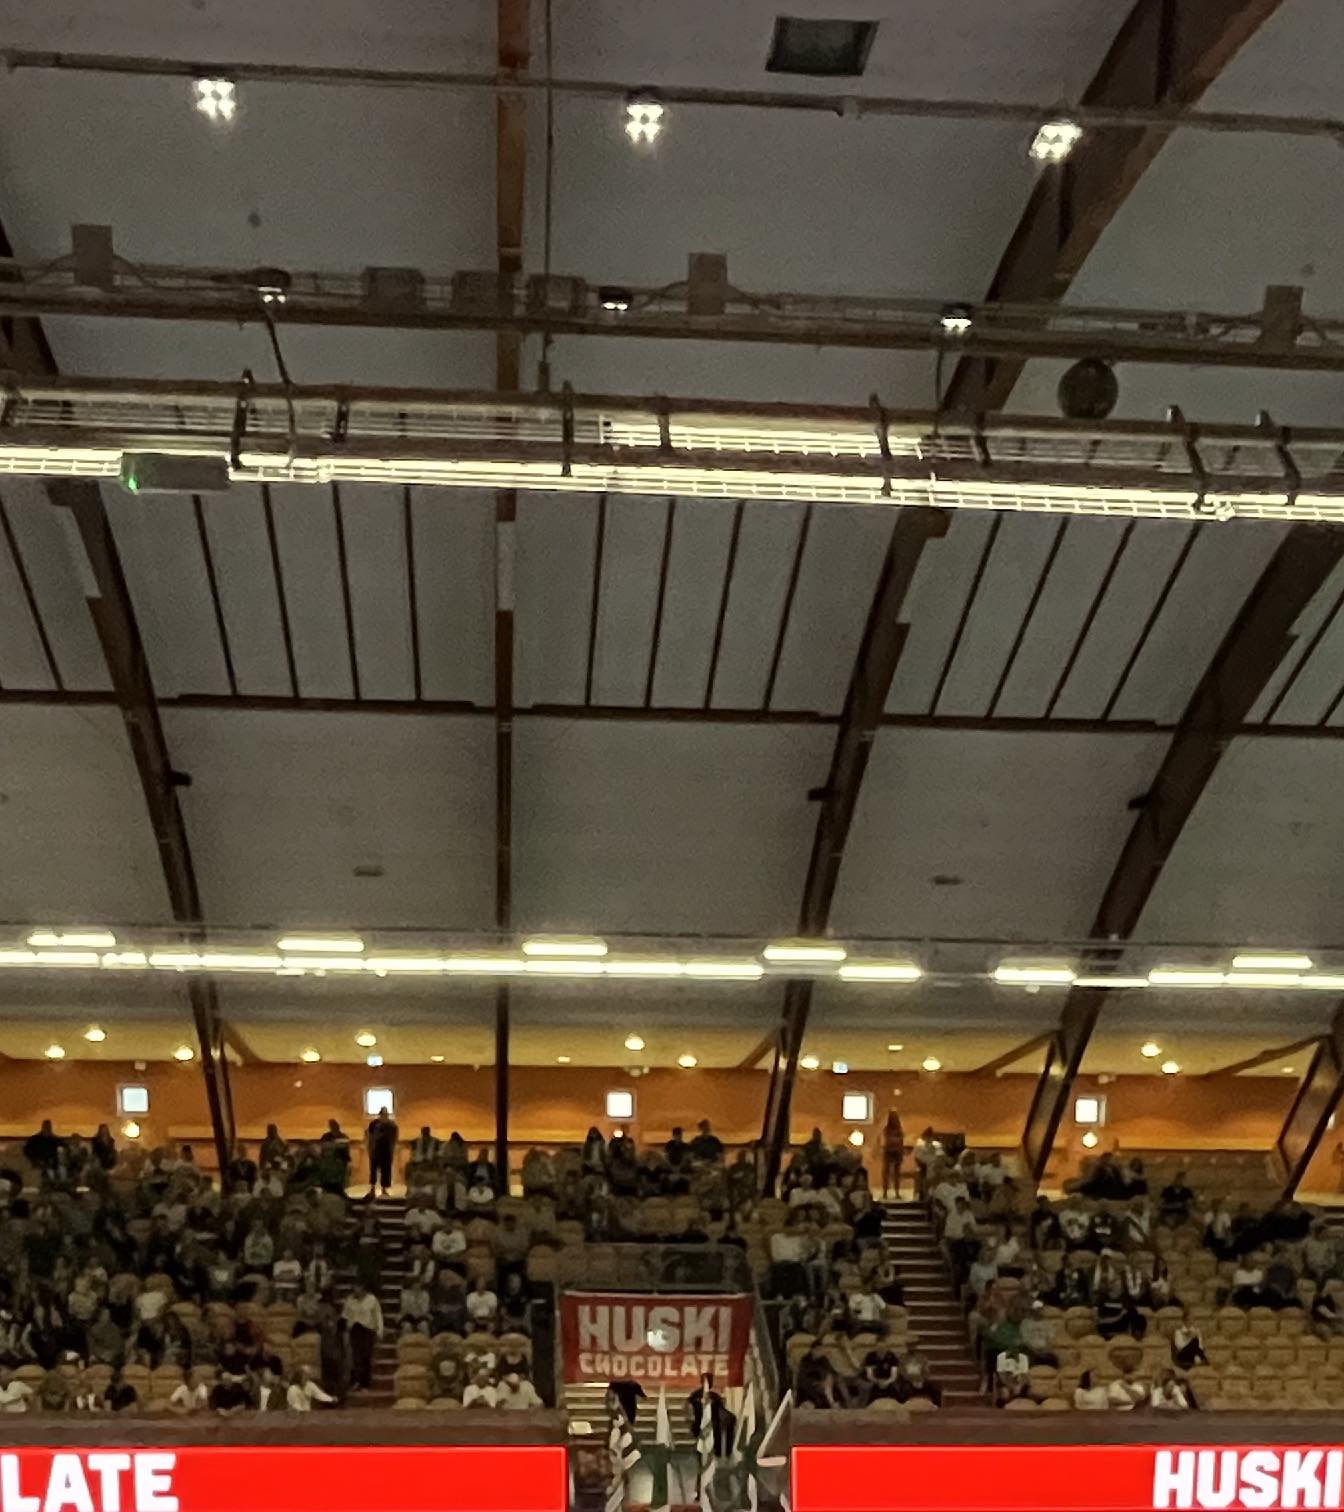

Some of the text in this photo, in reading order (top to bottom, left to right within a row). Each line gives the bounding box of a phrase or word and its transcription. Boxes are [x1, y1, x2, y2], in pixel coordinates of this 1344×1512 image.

[577, 1304, 732, 1352] HUSKI
[578, 1352, 730, 1377] CHOCOLATE
[1155, 1450, 1343, 1509] HUSKI
